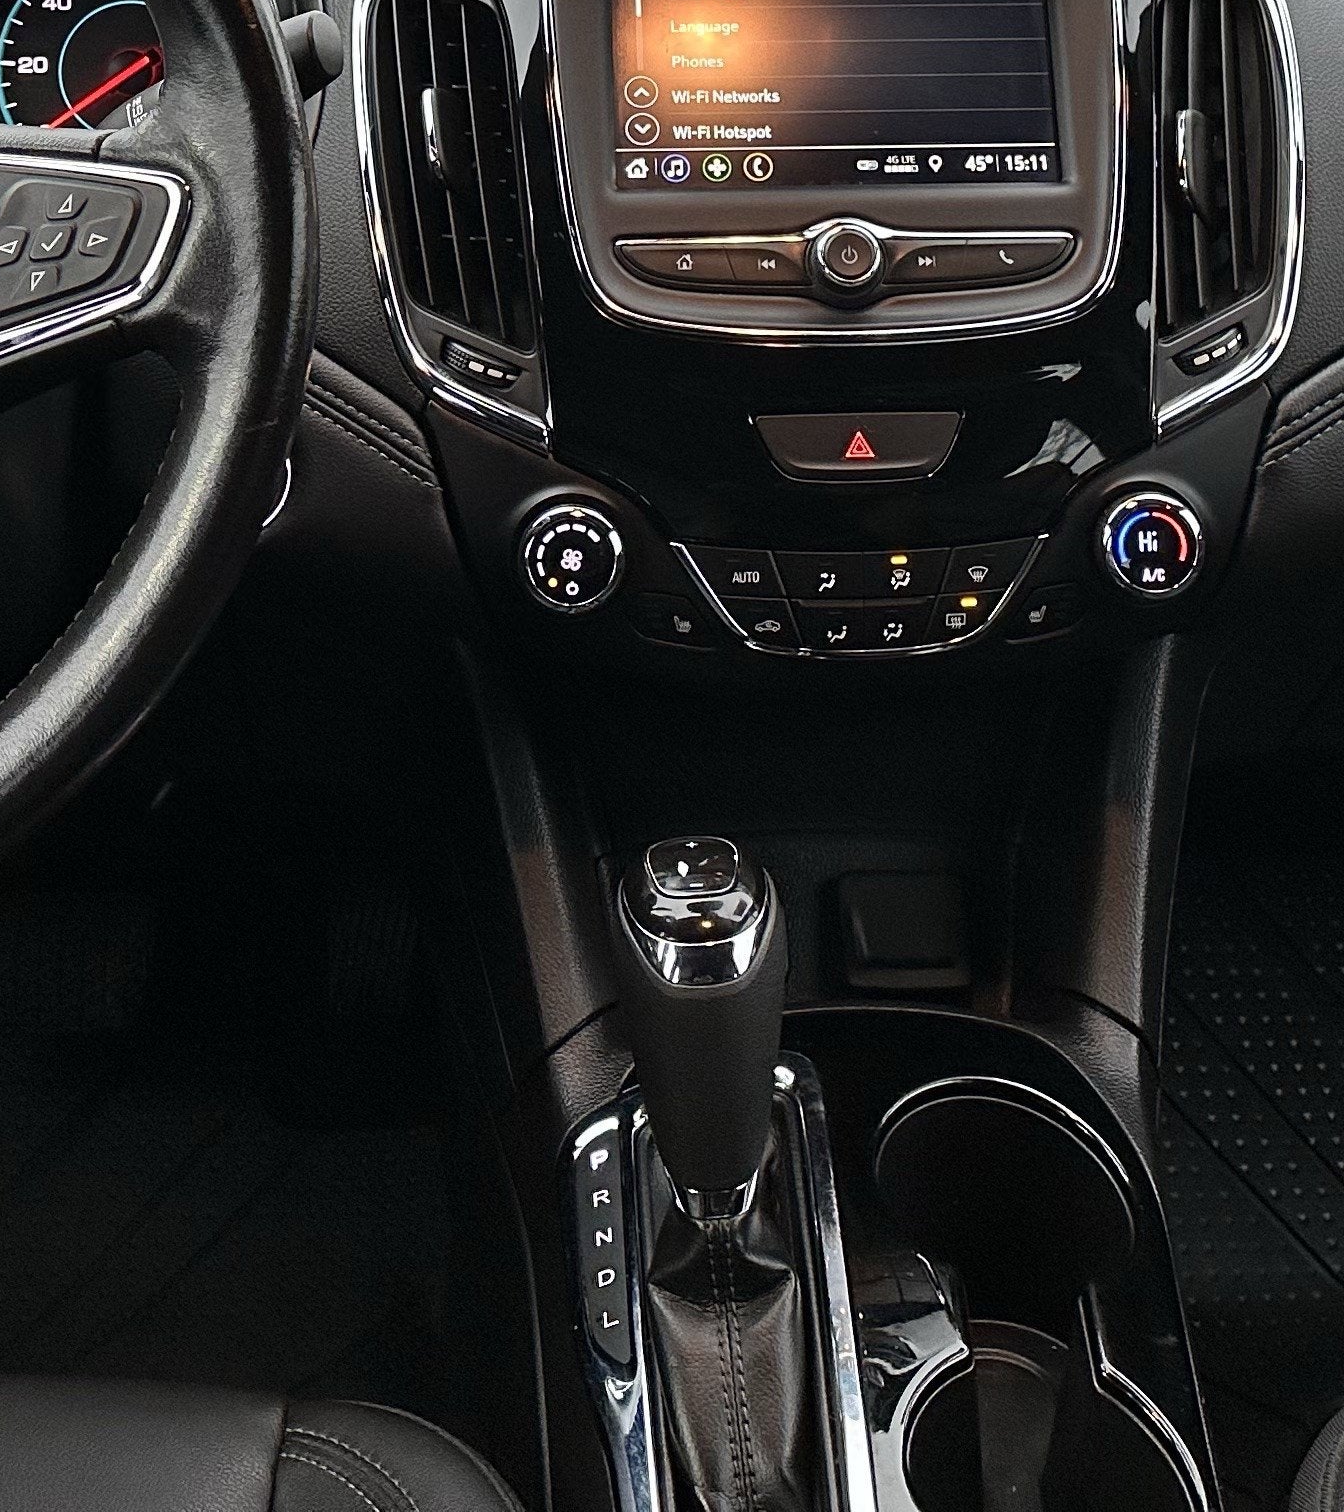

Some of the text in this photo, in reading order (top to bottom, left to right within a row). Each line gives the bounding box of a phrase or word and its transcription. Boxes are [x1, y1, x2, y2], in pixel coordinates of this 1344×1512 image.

[669, 20, 740, 36] Language
[17, 56, 49, 74] 20
[670, 55, 725, 68] Phones
[671, 88, 781, 104] Wi-Fi Networks
[672, 125, 773, 142] Wi-Fi Hotspot
[885, 155, 916, 164] 4G LTE
[964, 154, 1049, 172] 45° 15:11
[1138, 530, 1158, 552] Hi
[732, 571, 760, 583] AUTO
[1142, 568, 1166, 582] A/C
[589, 1148, 609, 1171] P
[592, 1189, 611, 1208] R
[594, 1229, 614, 1247] N
[597, 1269, 616, 1288] D
[602, 1311, 620, 1329] L
